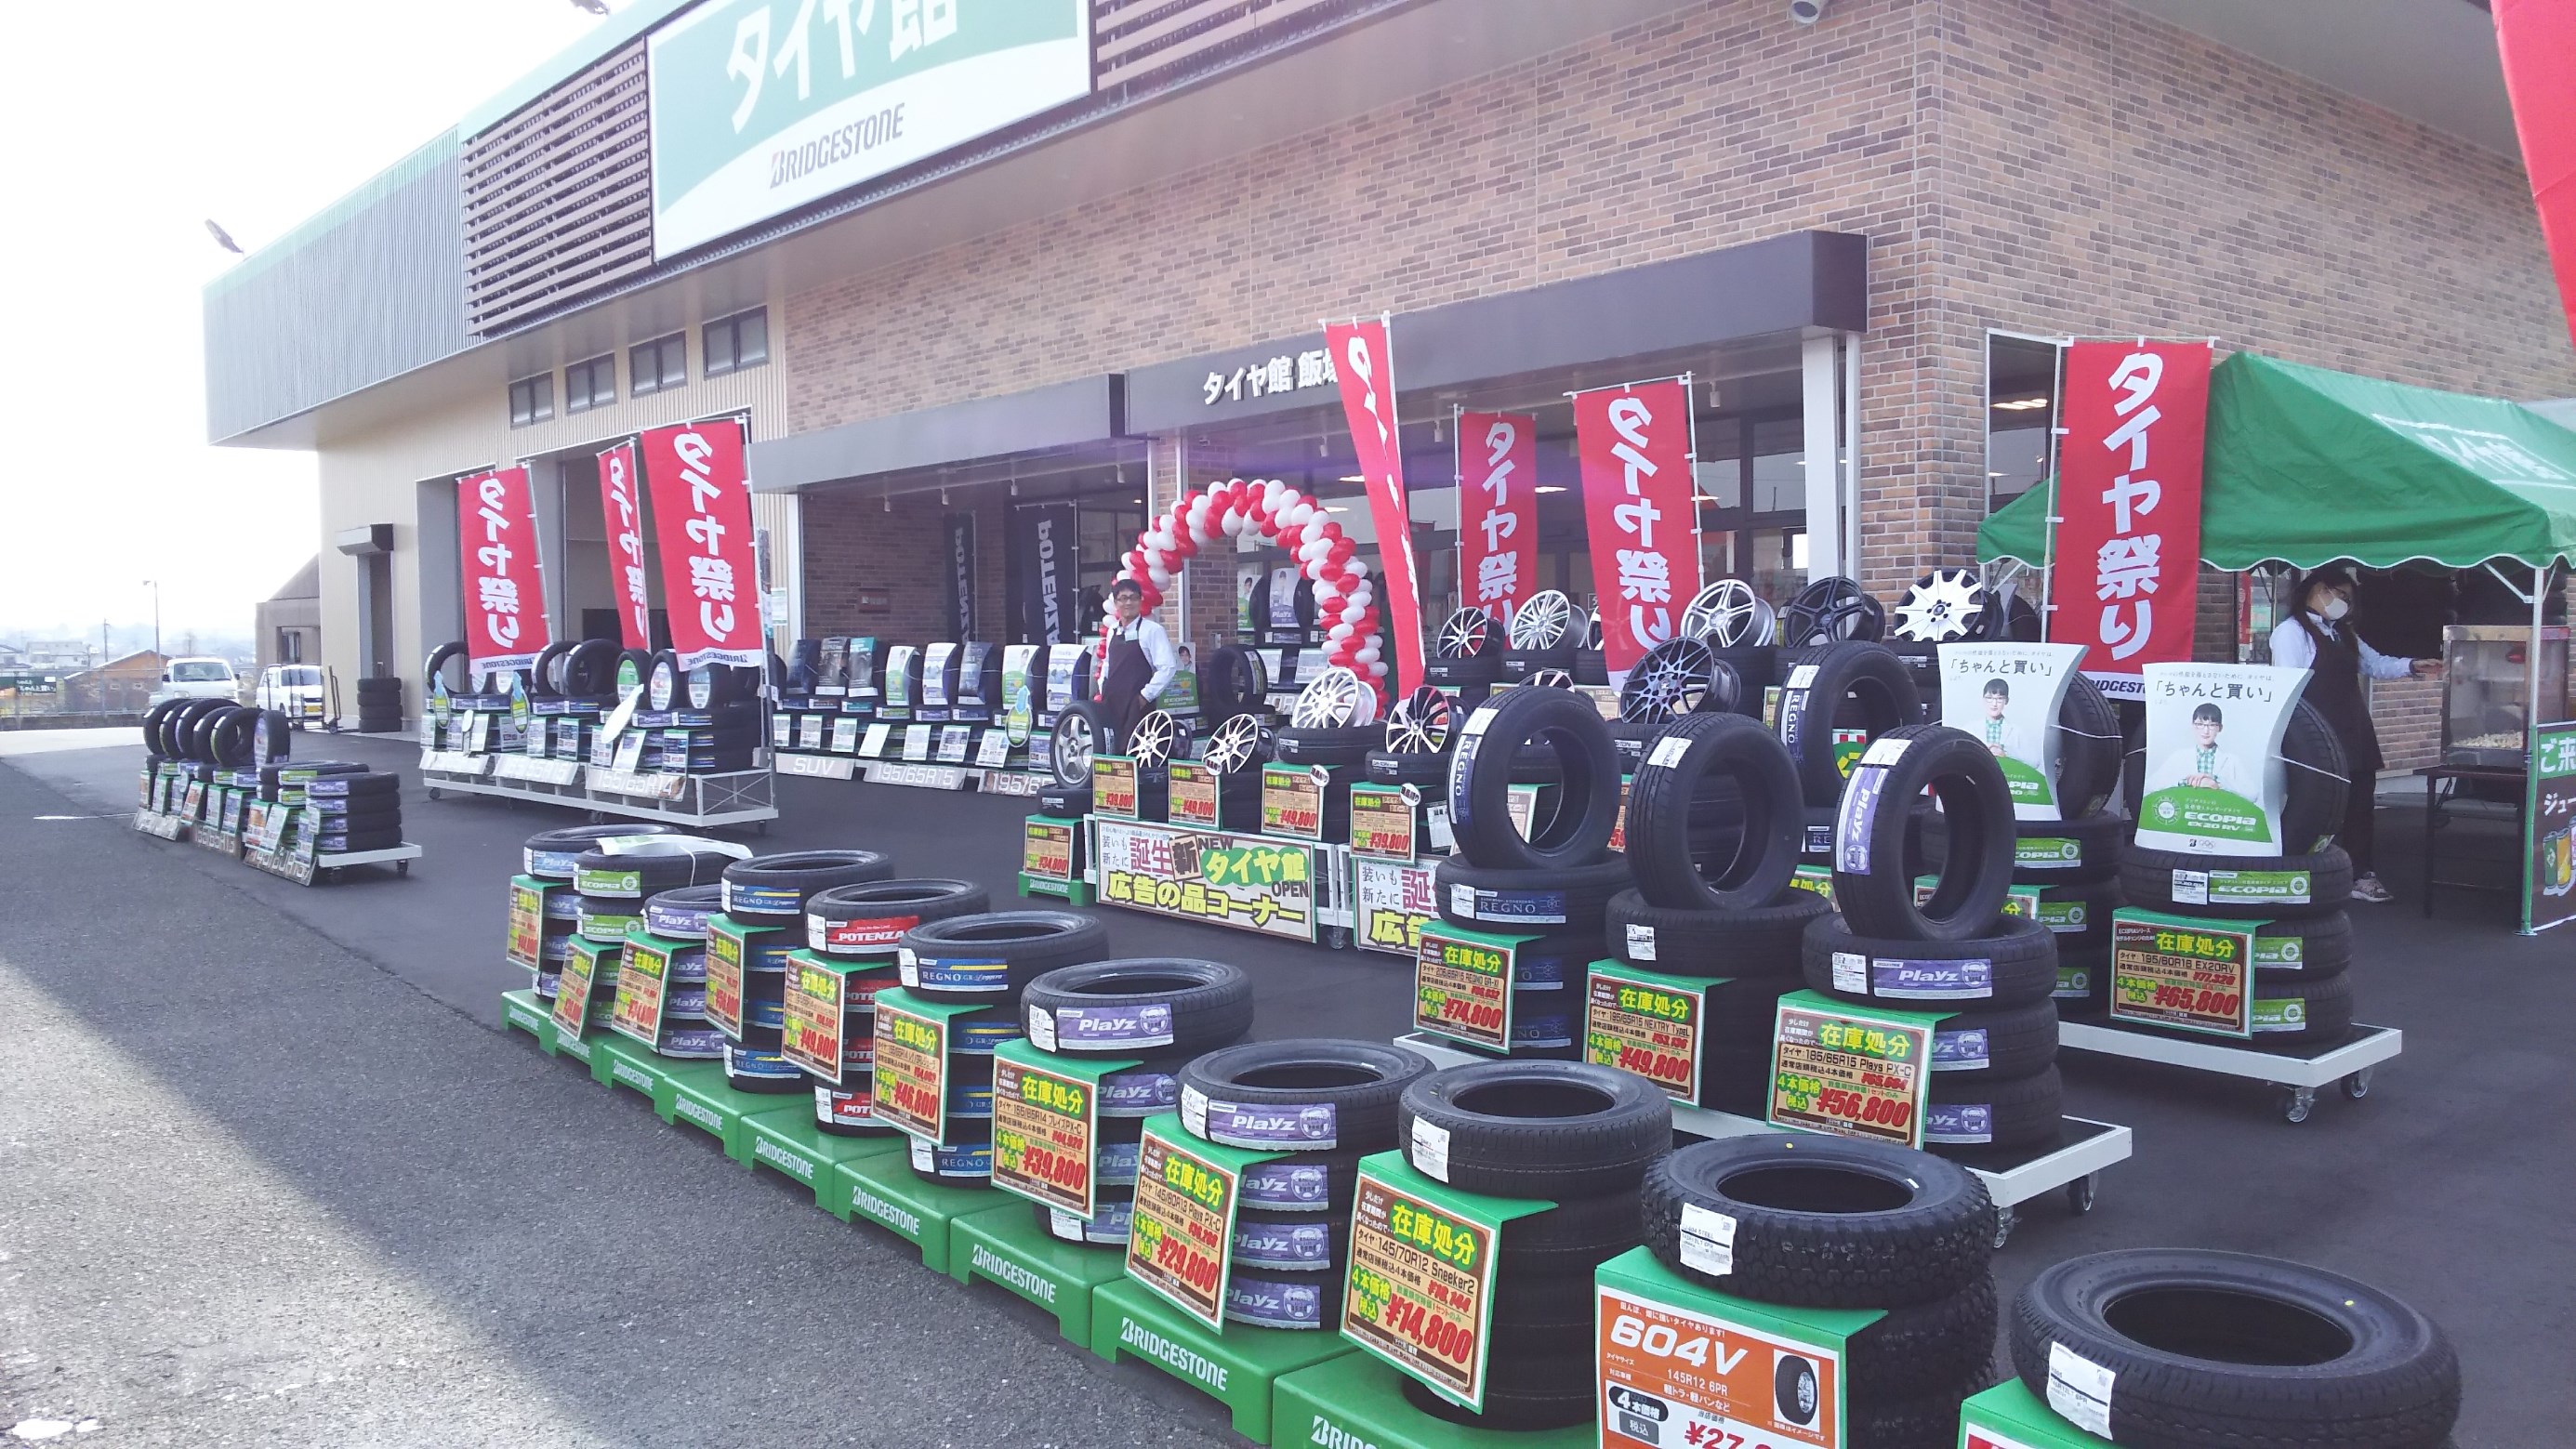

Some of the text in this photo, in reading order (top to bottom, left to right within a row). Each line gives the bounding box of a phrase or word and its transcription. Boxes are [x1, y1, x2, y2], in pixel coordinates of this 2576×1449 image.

[770, 102, 905, 189] BRIDGESTONE
[1203, 355, 1294, 405] タイヤ館
[2096, 351, 2163, 662] タイヤ祭り
[1478, 422, 1517, 636] タイヤ祭り
[1950, 658, 2053, 677] 「ちゃんと買い」
[2156, 681, 2273, 702] 「ちゃんと買い」
[1788, 693, 1801, 744] REGNO
[794, 757, 836, 776] SUV
[877, 763, 954, 786] 195/65R15
[1455, 740, 1472, 797] REGNO
[1280, 809, 1317, 827] ¥49,800
[1850, 788, 1870, 842] Playz
[2185, 811, 2256, 825] ECOPIA
[1103, 836, 1127, 850] 装いも
[1129, 836, 1173, 875] 誕生
[1172, 840, 1198, 875] 新
[1198, 837, 1234, 850] NEW
[1369, 834, 1409, 852] ¥39,800
[1103, 853, 1129, 868] 新たに
[1206, 850, 1306, 884] タイヤ館
[1272, 880, 1309, 898] OPEN
[1362, 866, 1397, 886] 装いも
[2218, 885, 2288, 895] ECOPIA
[1106, 869, 1305, 928] 広告の品コーナー
[1362, 886, 1400, 906] 新たに
[1480, 902, 1535, 915] REGNO
[659, 915, 691, 927] Playz
[838, 930, 906, 942] POTENZA
[1445, 945, 1501, 973] 在庫処分
[2156, 931, 2236, 959] 在庫処分
[922, 971, 961, 981] REGNO
[1898, 968, 1959, 984] Playz
[1444, 998, 1502, 1030] ¥74,800
[1619, 988, 1689, 1020] 在庫処分
[2154, 984, 2239, 1016] ¥65,800
[894, 1019, 937, 1051] 在庫処分
[1078, 1018, 1138, 1033] Playz
[1645, 1020, 1670, 1033] NEXTRY
[1820, 1023, 1910, 1058] 在庫処分
[671, 1036, 707, 1047] Playz
[1589, 1034, 1621, 1054] 4本価格
[614, 1059, 654, 1091] BRIDGESTONE
[1618, 1046, 1690, 1083] ¥49,800
[1781, 1060, 1853, 1079] 通常店頭税込4本価格
[1783, 1047, 1804, 1058] タイヤ:
[1860, 1058, 1883, 1073] Plays
[1886, 1063, 1911, 1077] PX-C
[894, 1080, 938, 1119] ¥46,800
[1023, 1075, 1083, 1114] 在庫処分
[1777, 1074, 1821, 1098] 4本価格
[676, 1093, 722, 1131] BRIDGESTONE
[1786, 1095, 1808, 1111] 税込
[1816, 1087, 1910, 1127] ¥56,800
[1232, 1114, 1296, 1131] Playz
[997, 1129, 1025, 1154] 4本価格
[755, 1136, 813, 1180] BRIDGESTONE
[942, 1157, 984, 1168] REGNO
[1023, 1144, 1086, 1191] ¥39,800
[1166, 1156, 1223, 1207] 在庫処分
[852, 1185, 920, 1237] BRIDGESTONE
[1205, 1213, 1222, 1232] PX-C
[1134, 1212, 1162, 1243] 4本価格
[1392, 1204, 1475, 1266] 在庫処分
[972, 1244, 1056, 1304] BRIDGESTONE
[1157, 1234, 1218, 1294] ¥29,800
[1356, 1247, 1421, 1286] 通常店頭税込4本価格
[1379, 1236, 1475, 1294] 145/70R12 Sneeker2
[1353, 1269, 1391, 1301] 4本価格
[1359, 1297, 1379, 1321] 税込
[1385, 1293, 1473, 1364] ¥14,800
[1120, 1316, 1228, 1392] BRIDGESTONE
[1606, 1351, 1635, 1366] タイヤサイズ
[1610, 1314, 1749, 1376] 604V
[1668, 1368, 1729, 1397] 145R12 6PR
[1618, 1391, 1660, 1420] 4本価格
[1663, 1383, 1731, 1413] 軽トラ・軽バンなど
[1629, 1420, 1649, 1437] 税込
